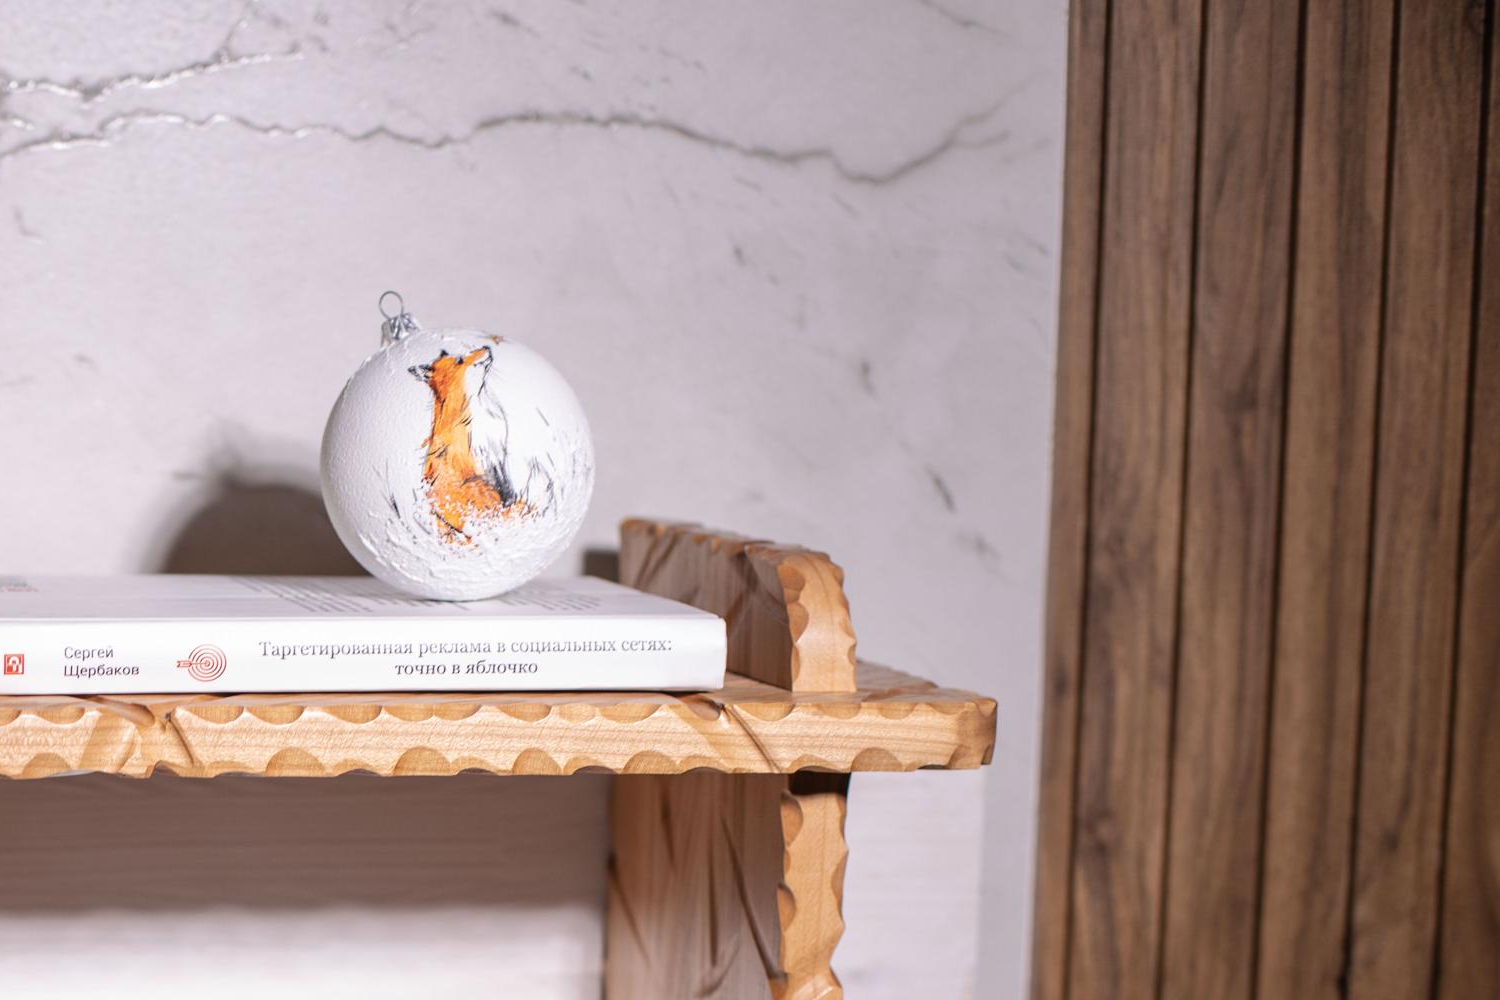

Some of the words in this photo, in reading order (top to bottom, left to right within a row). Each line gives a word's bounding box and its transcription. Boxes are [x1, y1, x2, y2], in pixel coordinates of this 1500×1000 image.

[63, 645, 114, 662] Сергей
[258, 641, 413, 660] Таргетированная
[418, 641, 491, 658] реклама
[497, 643, 506, 653] в
[510, 640, 616, 655] социальных
[621, 640, 672, 651] сетях:
[63, 663, 140, 679] Щербаков
[395, 663, 447, 675] точно
[452, 663, 460, 675] в
[466, 660, 538, 675] яблочко
